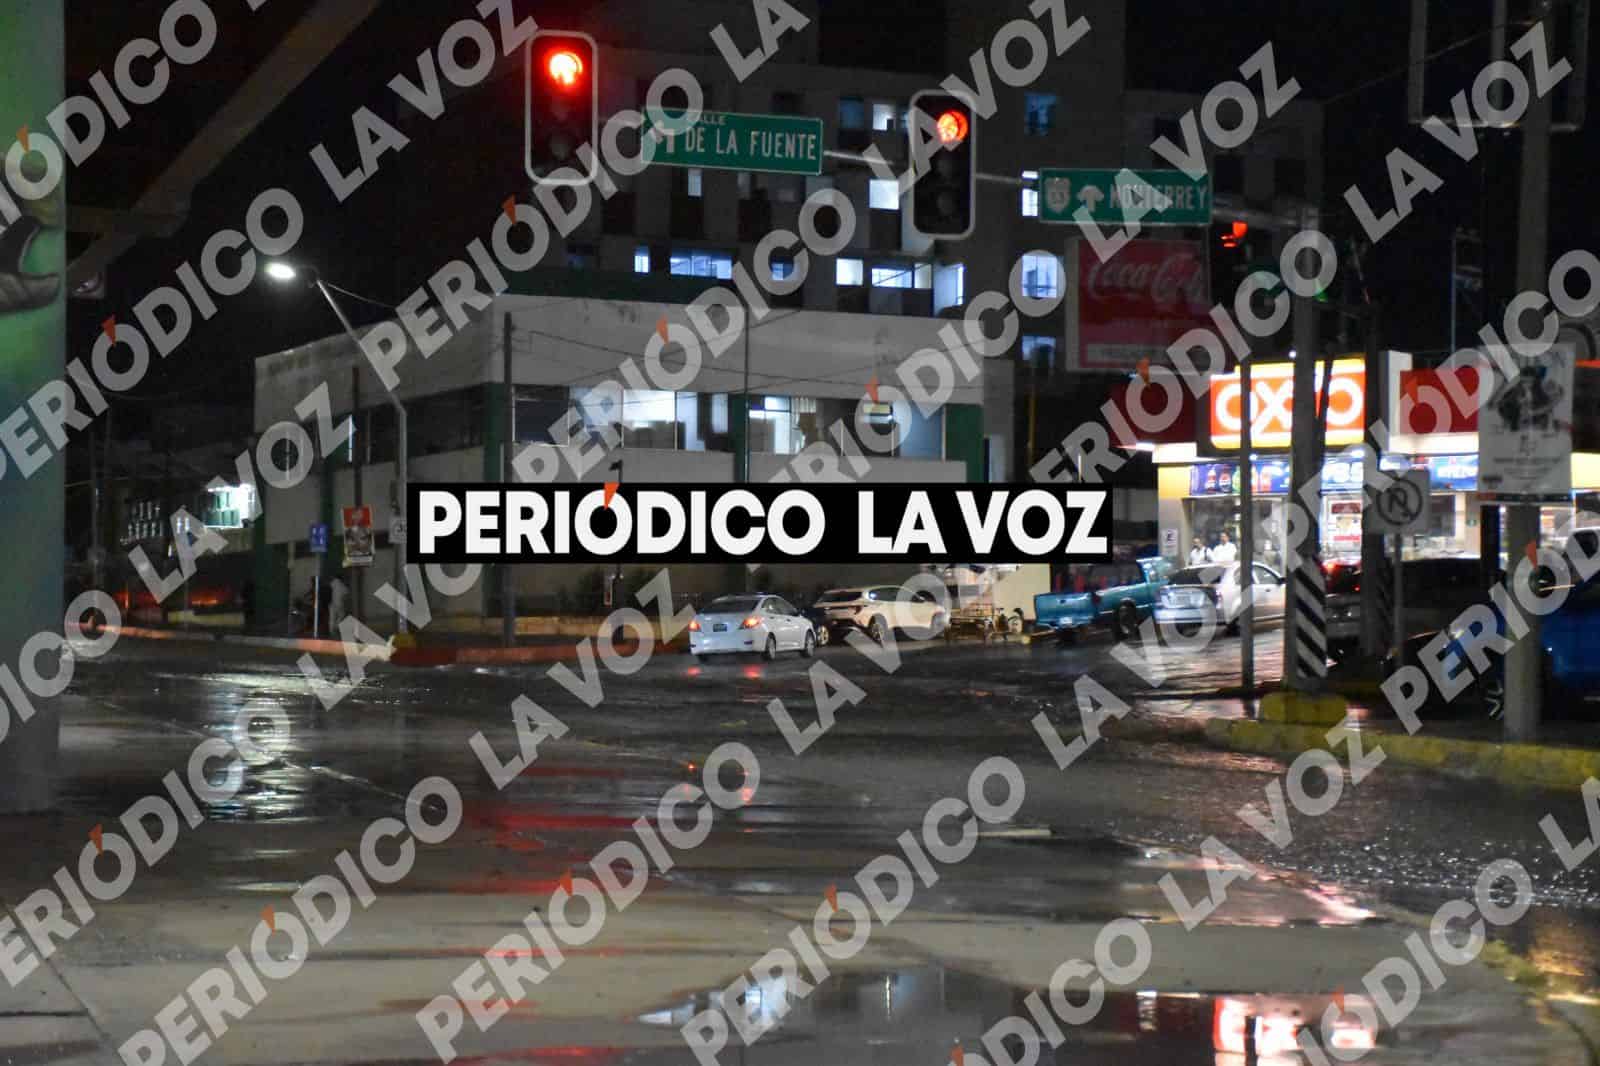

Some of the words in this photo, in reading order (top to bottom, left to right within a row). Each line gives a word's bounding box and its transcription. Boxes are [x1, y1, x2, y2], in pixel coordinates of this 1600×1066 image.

[685, 128, 706, 152] DE
[716, 128, 739, 155] LA
[750, 130, 817, 160] FUENTE
[1216, 377, 1363, 434] OXO
